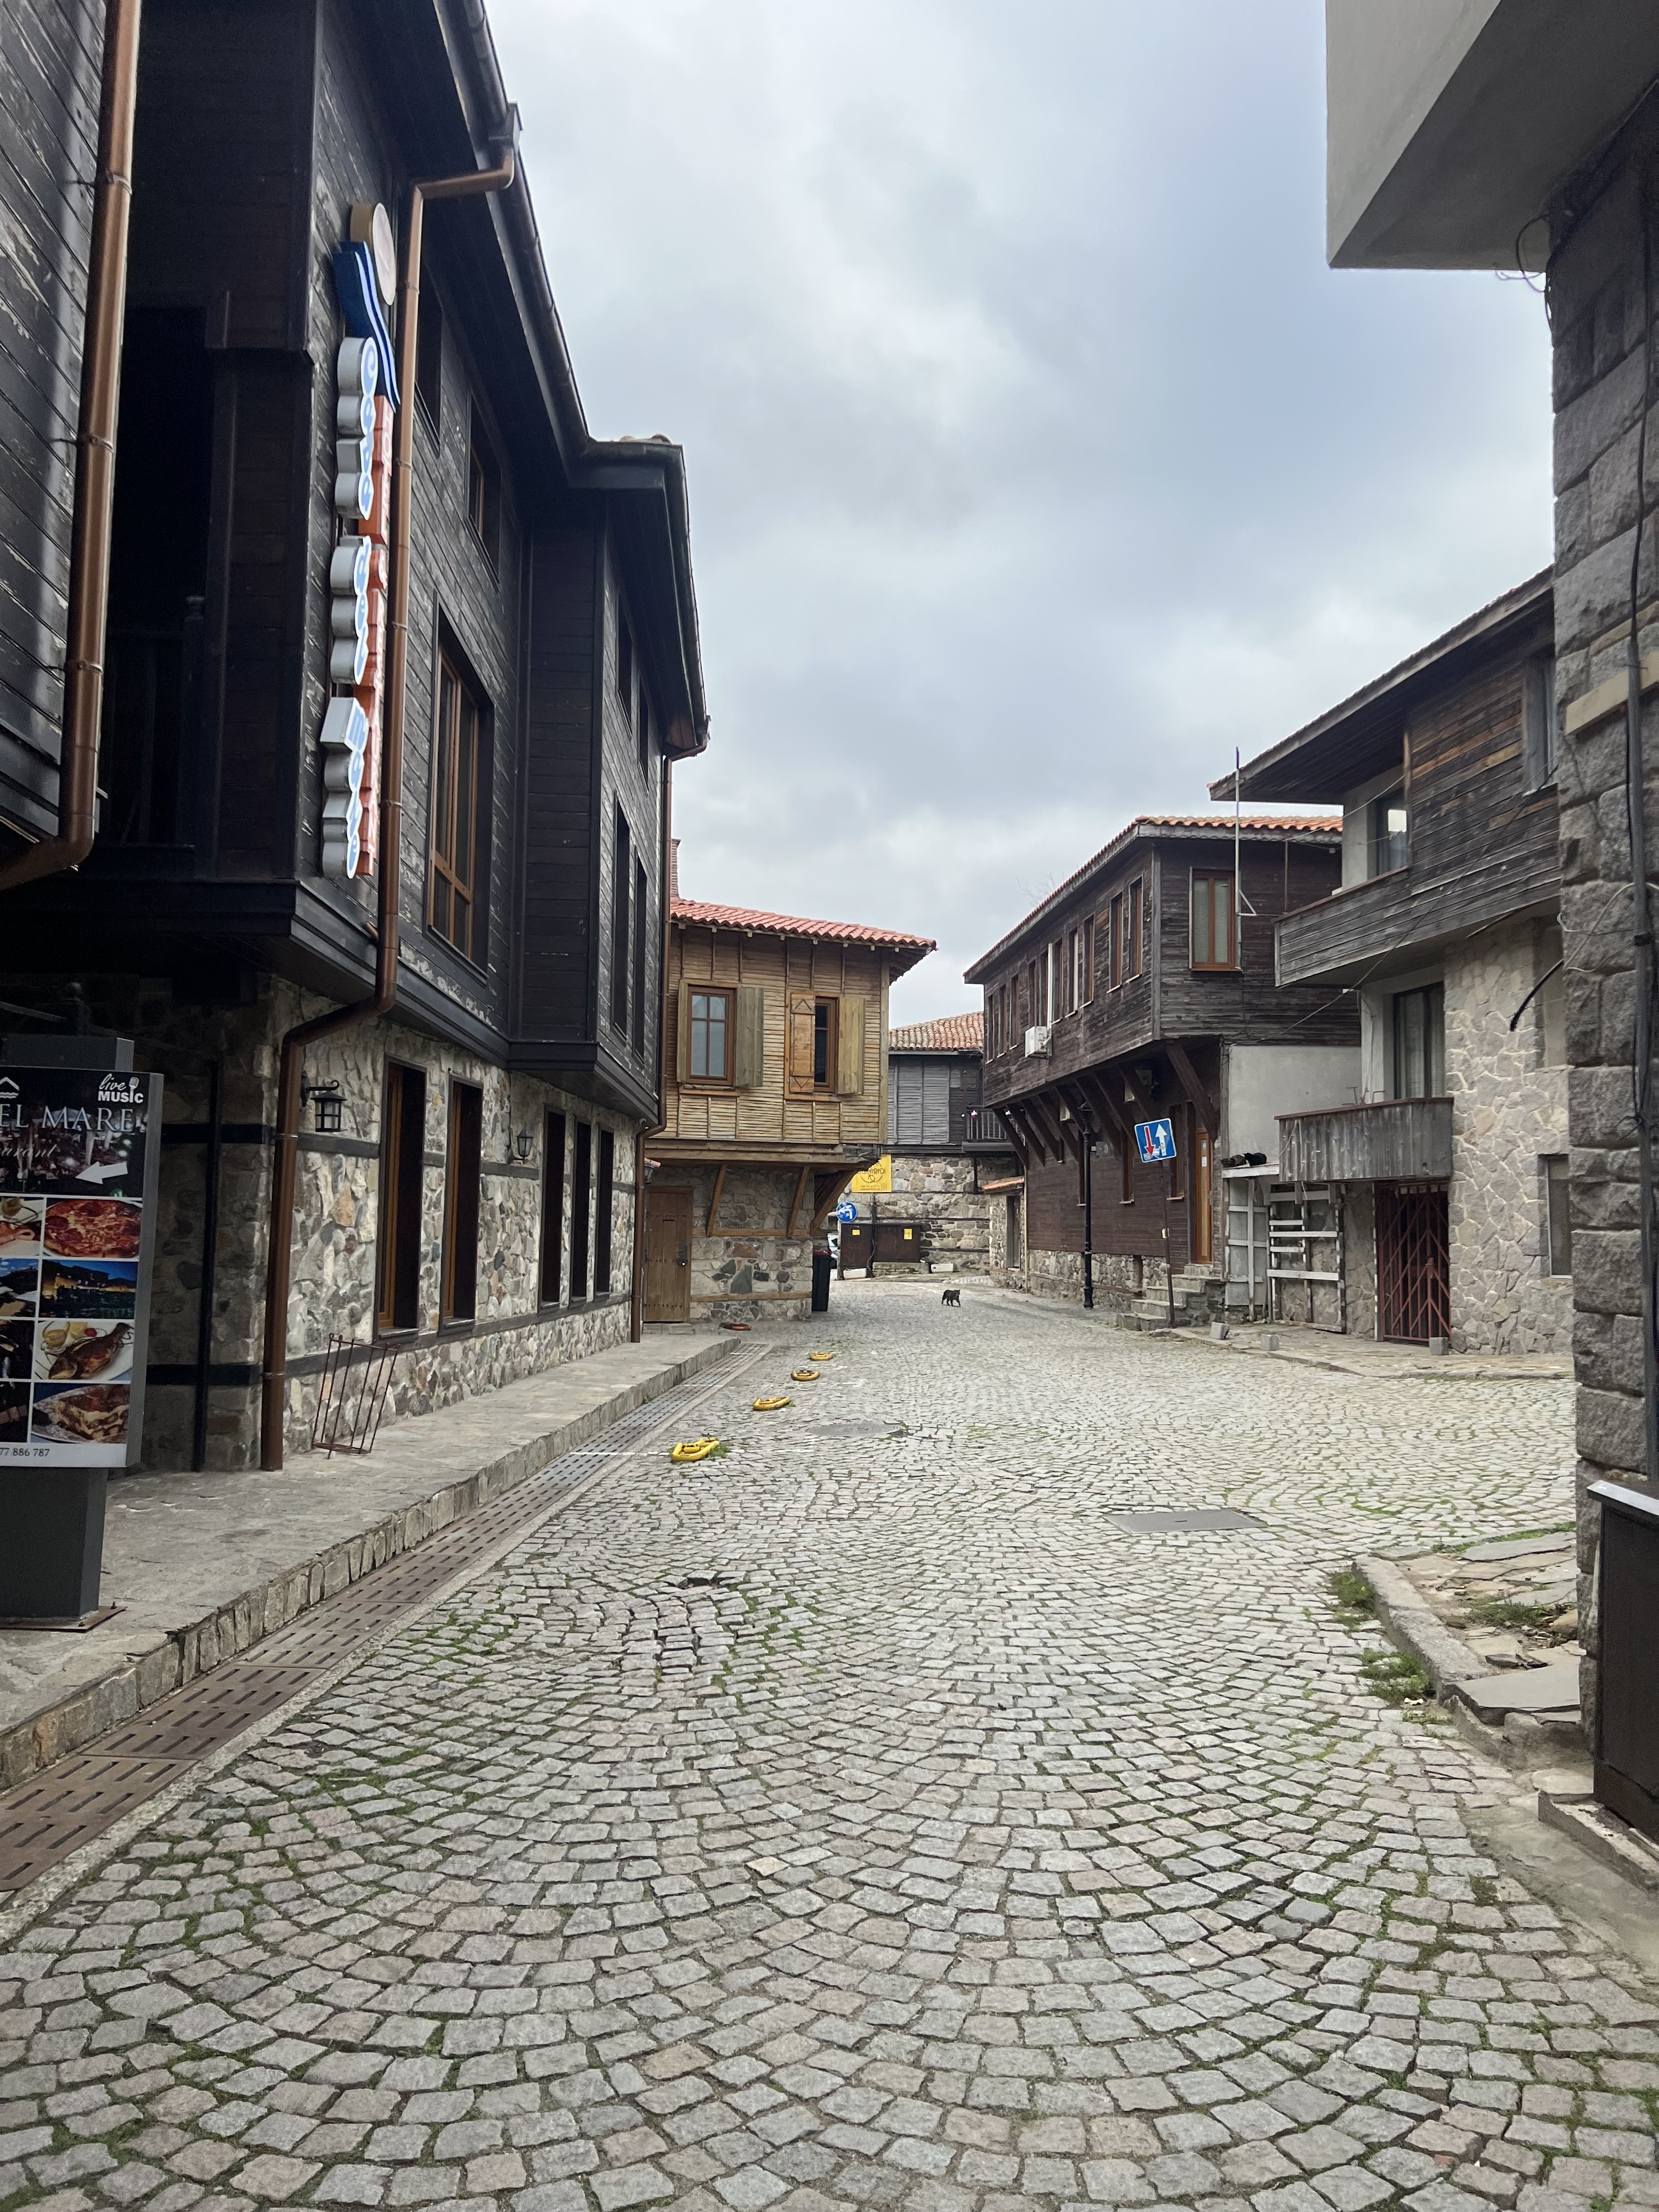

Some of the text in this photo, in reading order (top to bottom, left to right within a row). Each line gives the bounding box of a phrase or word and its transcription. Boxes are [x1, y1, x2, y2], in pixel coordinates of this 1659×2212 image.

[381, 397, 393, 542] HOTEL
[369, 594, 384, 874] RESTAURANT
[99, 1073, 126, 1091] live
[42, 1105, 133, 1132] MARE
[13, 1448, 30, 1457] 886
[33, 1448, 50, 1457] 787
